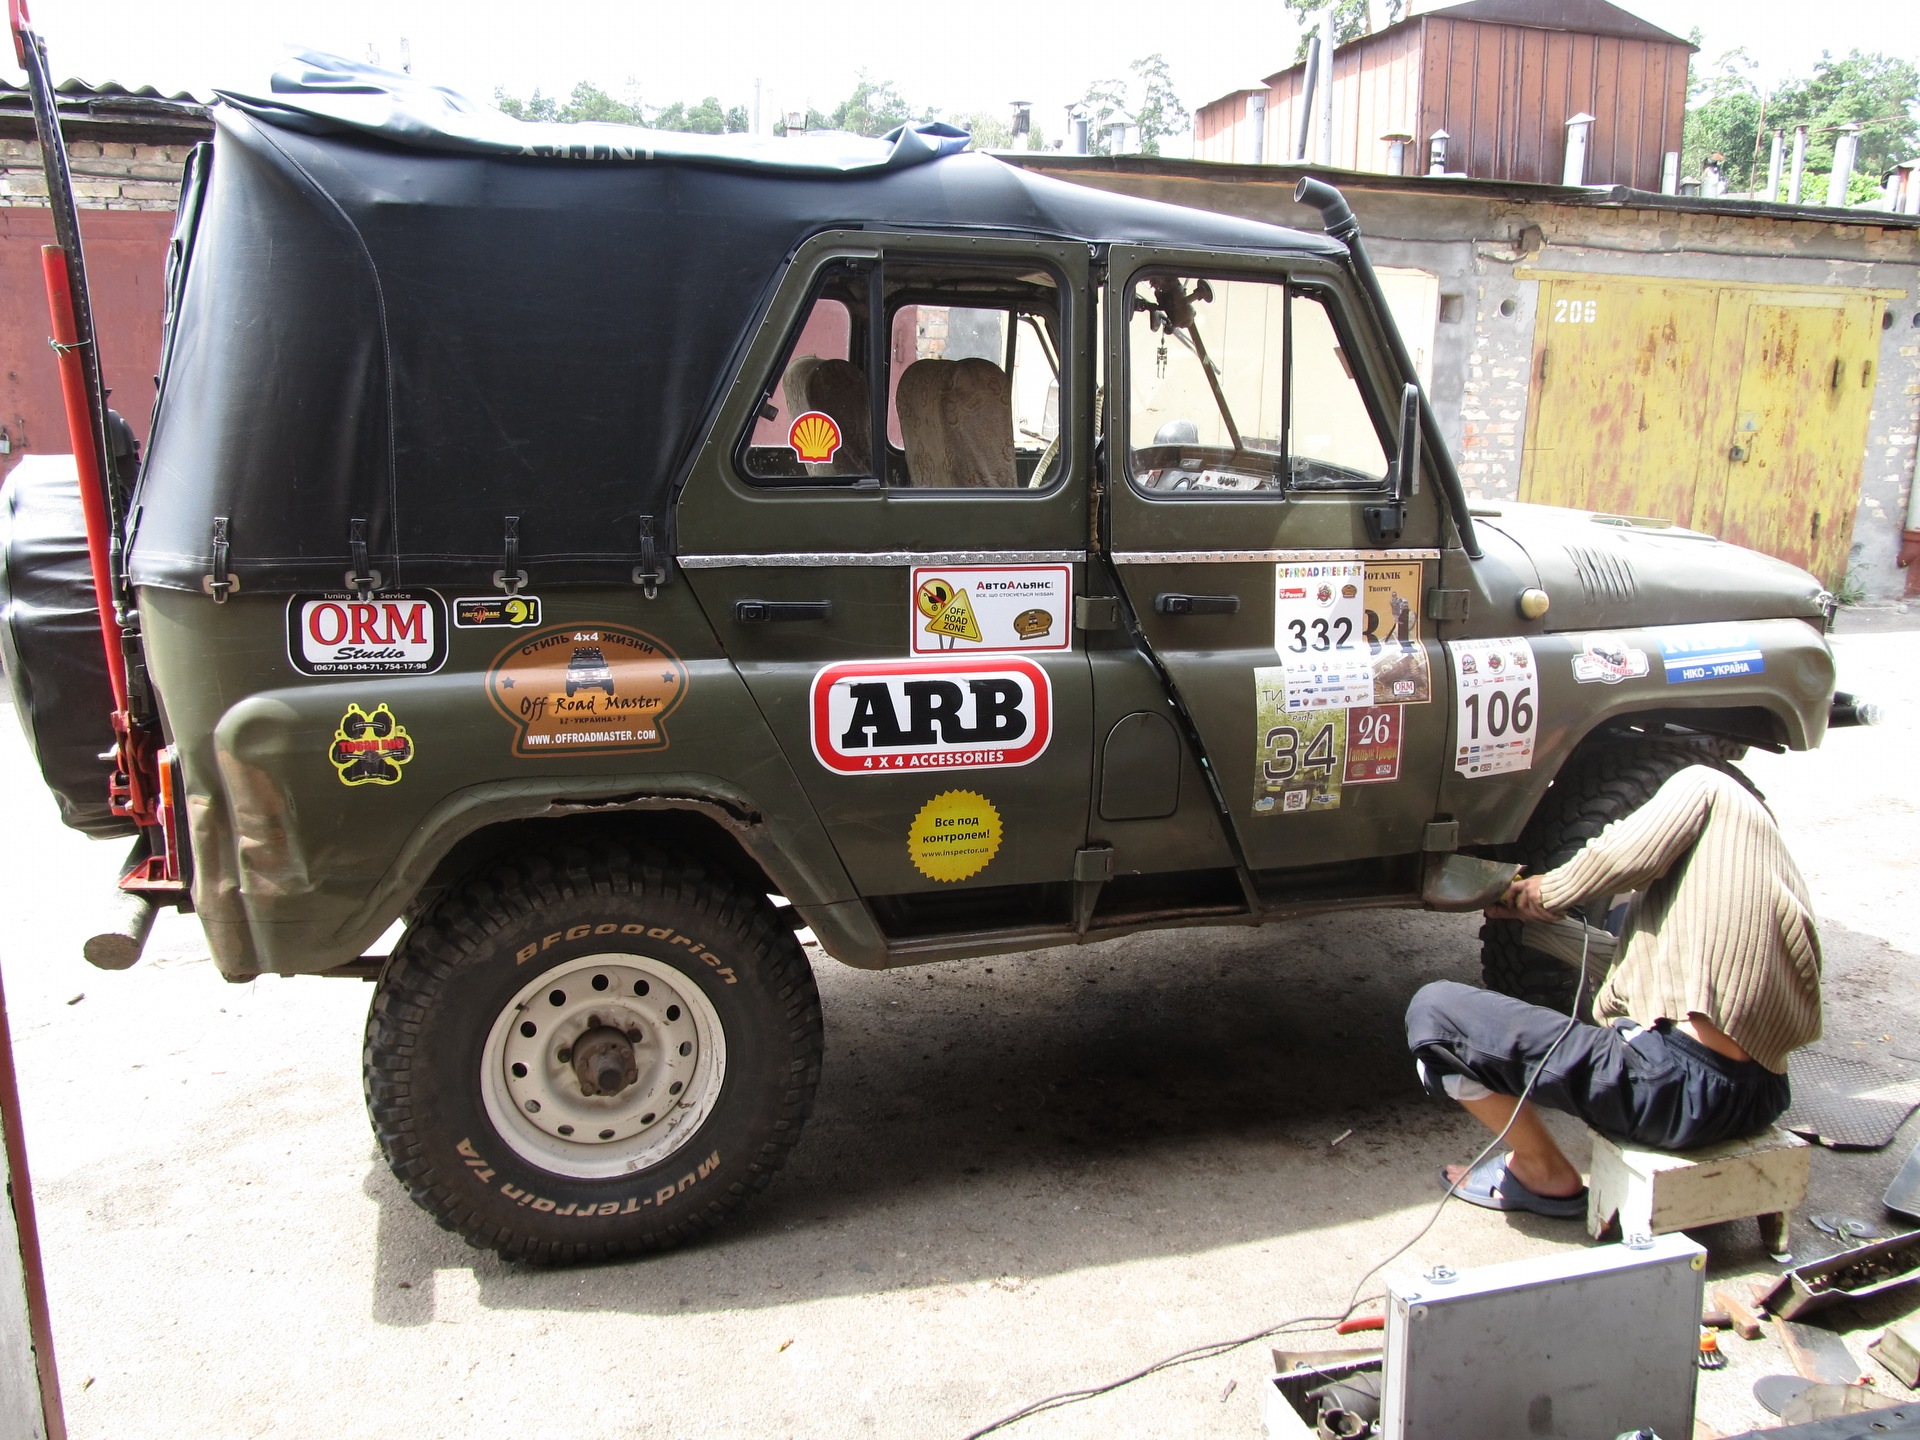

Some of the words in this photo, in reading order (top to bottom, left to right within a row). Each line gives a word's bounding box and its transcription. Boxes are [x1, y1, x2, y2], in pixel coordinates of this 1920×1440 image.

[1554, 299, 1597, 323] 206
[1278, 567, 1320, 578] OFFROAD
[1321, 566, 1342, 577] FREE
[1343, 565, 1362, 577] FEST
[976, 581, 1051, 591] АвтоАльянс
[323, 592, 352, 600] Tuning
[380, 592, 412, 600] Service
[949, 606, 967, 617] OFF
[309, 603, 428, 645] ORM
[942, 622, 966, 634] ZONE
[944, 614, 968, 626] ROAD
[1288, 616, 1355, 654] 332
[522, 632, 570, 657] СТИЛЬ
[573, 632, 600, 642] 4x4
[602, 633, 655, 656] ЖИЗНИ
[333, 647, 406, 661] Studio
[313, 664, 336, 672] (067)
[1601, 671, 1617, 680] 2010
[1712, 661, 1750, 676] УКРАЇНА
[520, 696, 549, 722] Off
[555, 695, 598, 715] Road
[604, 696, 661, 711] Master
[842, 678, 1028, 750] ARB
[1465, 686, 1534, 740] 106
[1358, 713, 1391, 745] 26
[527, 729, 657, 746] WWW.OFFROADMASTER.COM
[339, 740, 380, 753] TOUGH
[1263, 722, 1338, 781] 34
[863, 757, 874, 768] 4
[894, 755, 905, 767] 4
[909, 750, 1005, 767] ACCESSORIES
[935, 818, 955, 827] Все
[957, 817, 979, 826] под
[922, 829, 990, 843] контролем!
[921, 847, 989, 858] www.inspector.ua
[516, 923, 738, 986] BFGoodrich
[455, 1137, 497, 1184] T/A
[500, 1150, 721, 1217] Mud-Terrain
